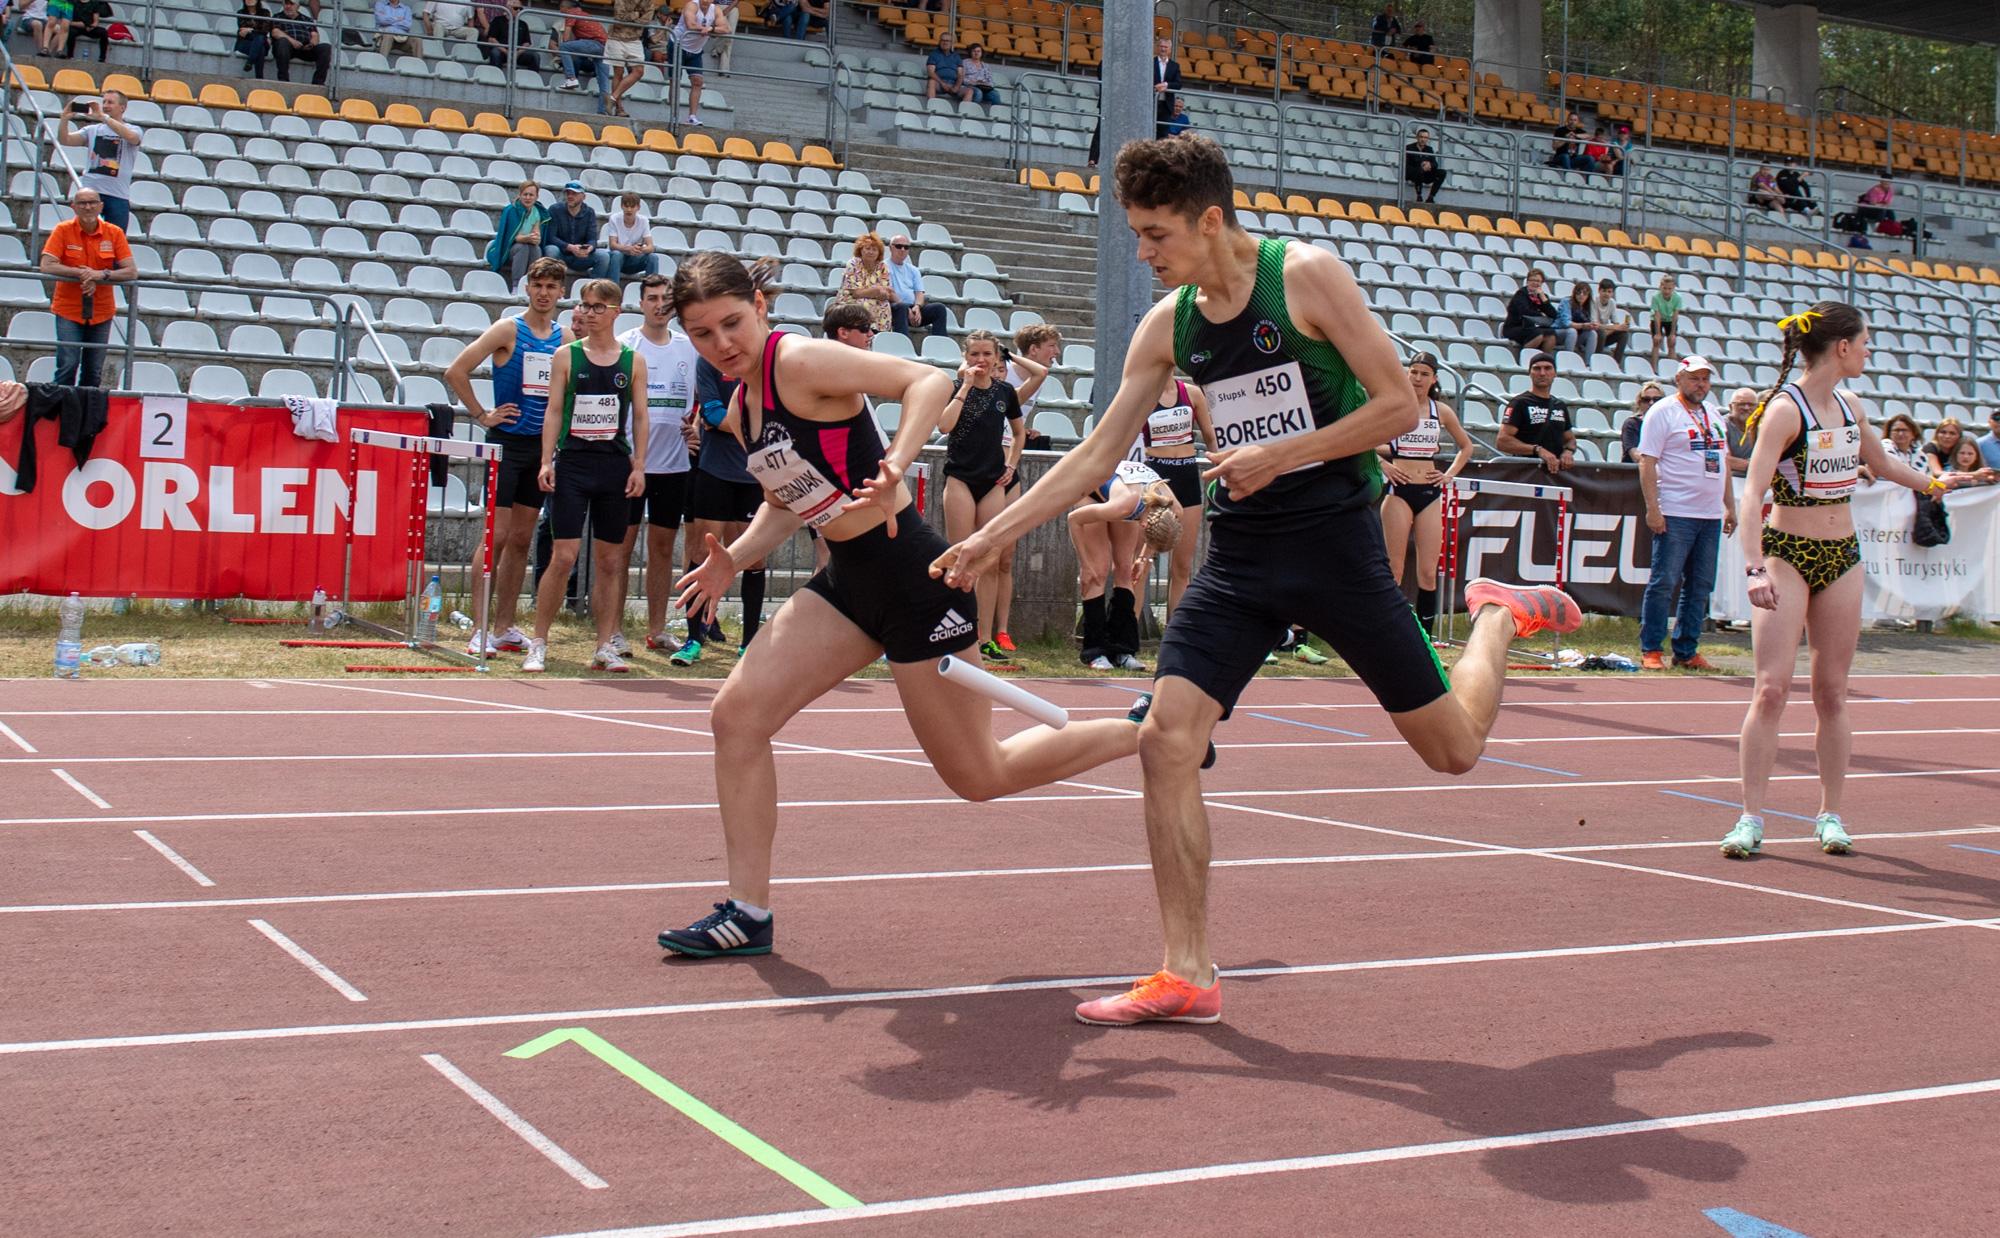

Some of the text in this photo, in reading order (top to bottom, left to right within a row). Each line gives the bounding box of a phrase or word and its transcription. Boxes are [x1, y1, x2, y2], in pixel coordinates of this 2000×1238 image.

[538, 370, 550, 381] PE
[1218, 372, 1292, 402] Słupsk 450
[598, 398, 616, 407] 481
[1172, 408, 1189, 417] 478
[573, 413, 617, 424] TWARDOWSKI
[1214, 407, 1307, 449] BORECKI
[1424, 421, 1437, 429] 582
[152, 412, 173, 446] 2
[764, 448, 788, 471] 477
[1157, 458, 1183, 466] NIKE
[62, 458, 378, 536] ORLEN
[1857, 524, 1909, 544] isterst
[1465, 509, 1652, 585] FUEL
[1885, 558, 1890, 575] i
[1896, 558, 1967, 581] Turystyki
[929, 622, 973, 642] adidas
